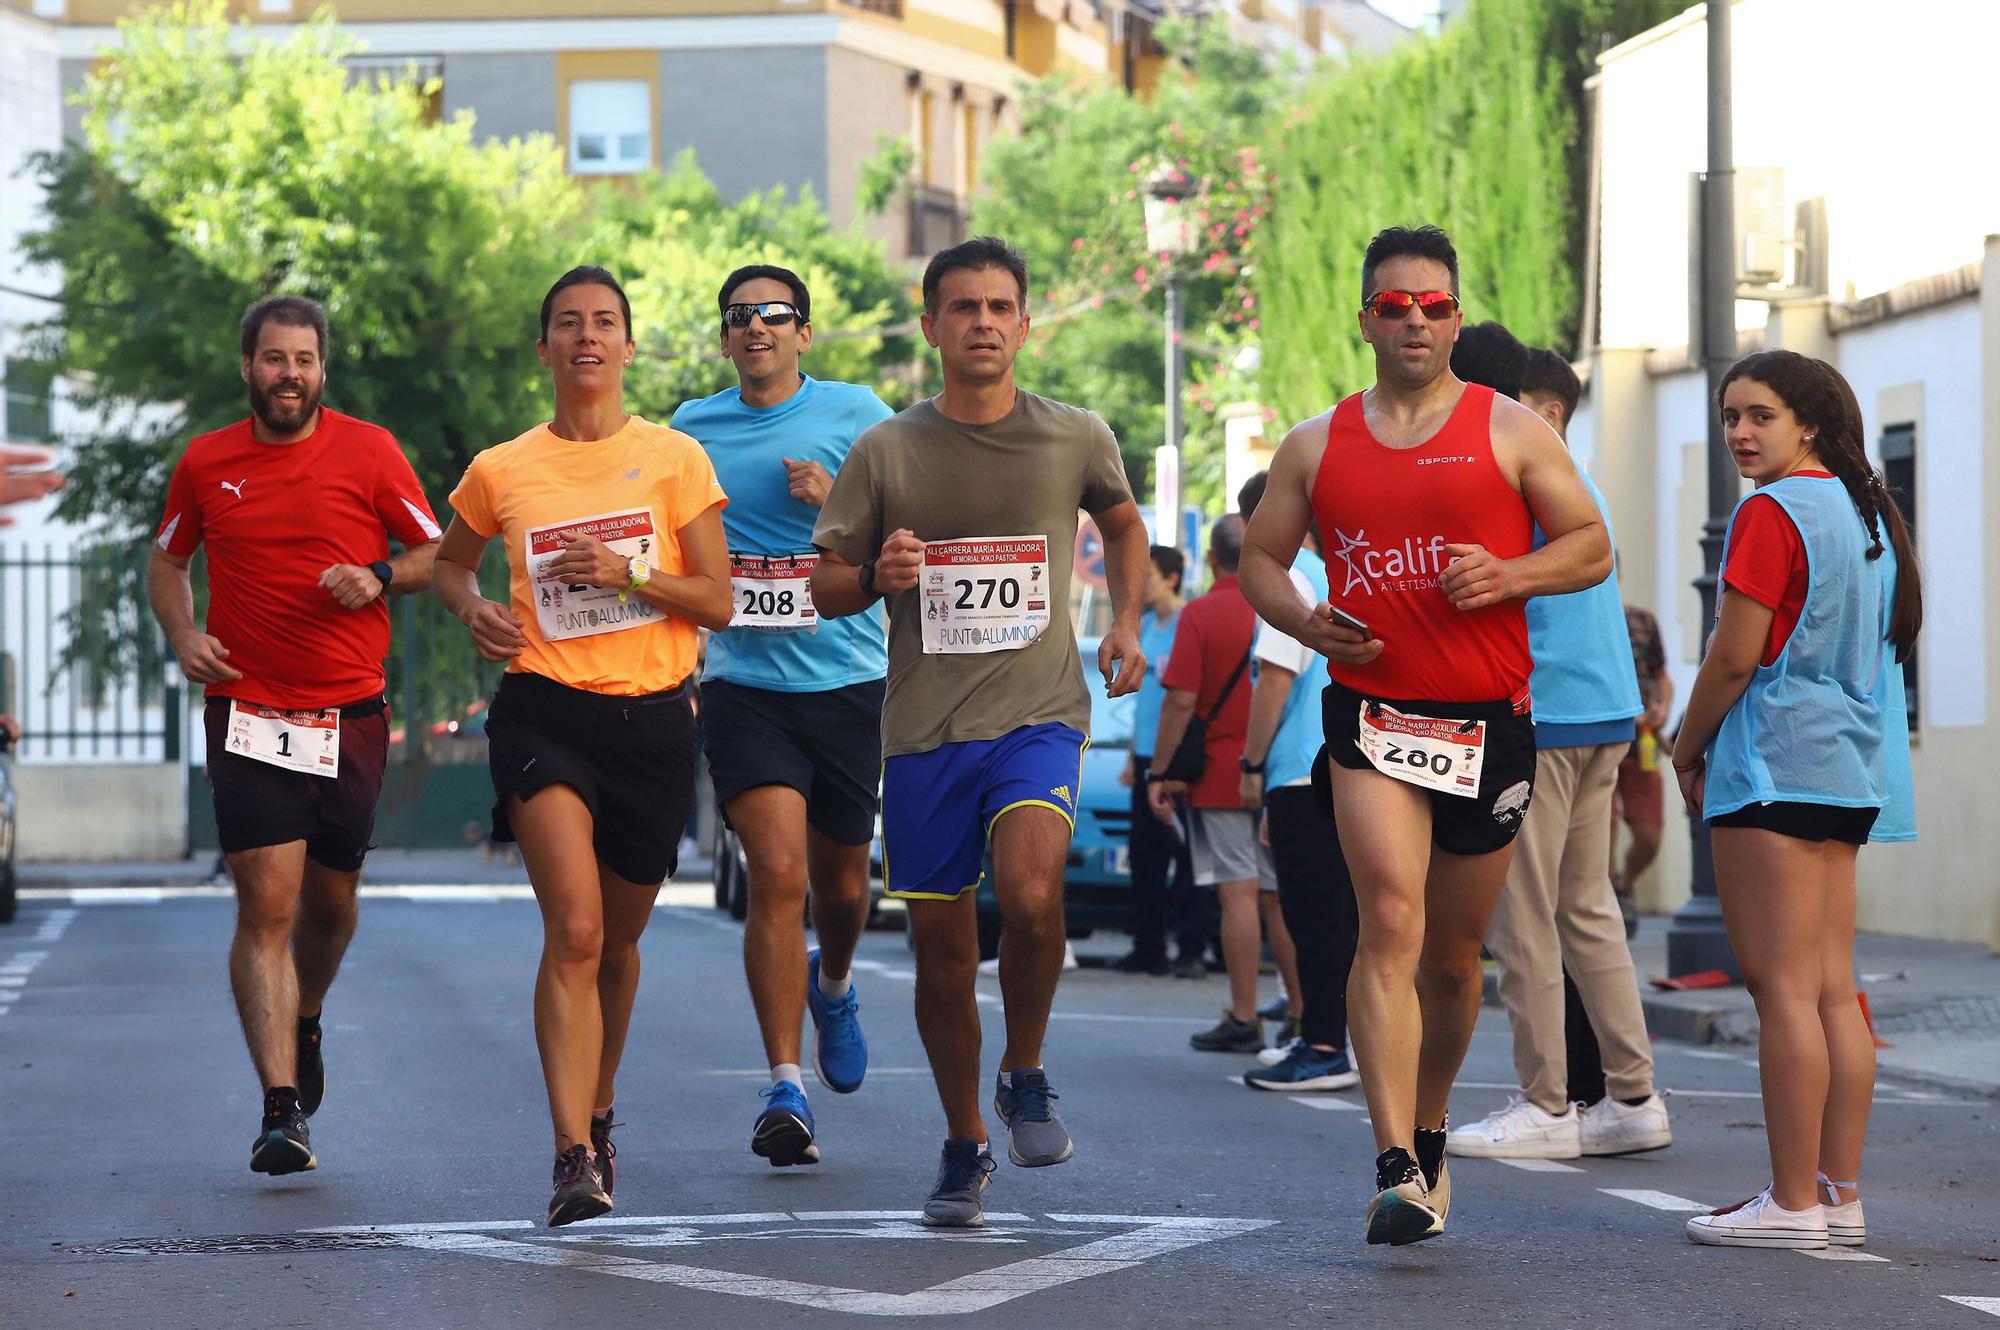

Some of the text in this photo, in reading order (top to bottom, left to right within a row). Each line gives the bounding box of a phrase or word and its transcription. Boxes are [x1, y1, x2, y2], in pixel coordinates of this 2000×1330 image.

[1417, 456, 1465, 465] GSPORT
[939, 545, 971, 555] CARRERA
[973, 543, 994, 554] MARÍA
[951, 554, 980, 563] MEMORIAL
[981, 554, 995, 562] KIKO
[1364, 535, 1461, 578] calif
[954, 577, 1020, 610] 270
[742, 589, 795, 616] 208
[1385, 721, 1415, 735] MEMORIAL
[1408, 720, 1431, 730] MARÍA
[276, 731, 292, 757] 1
